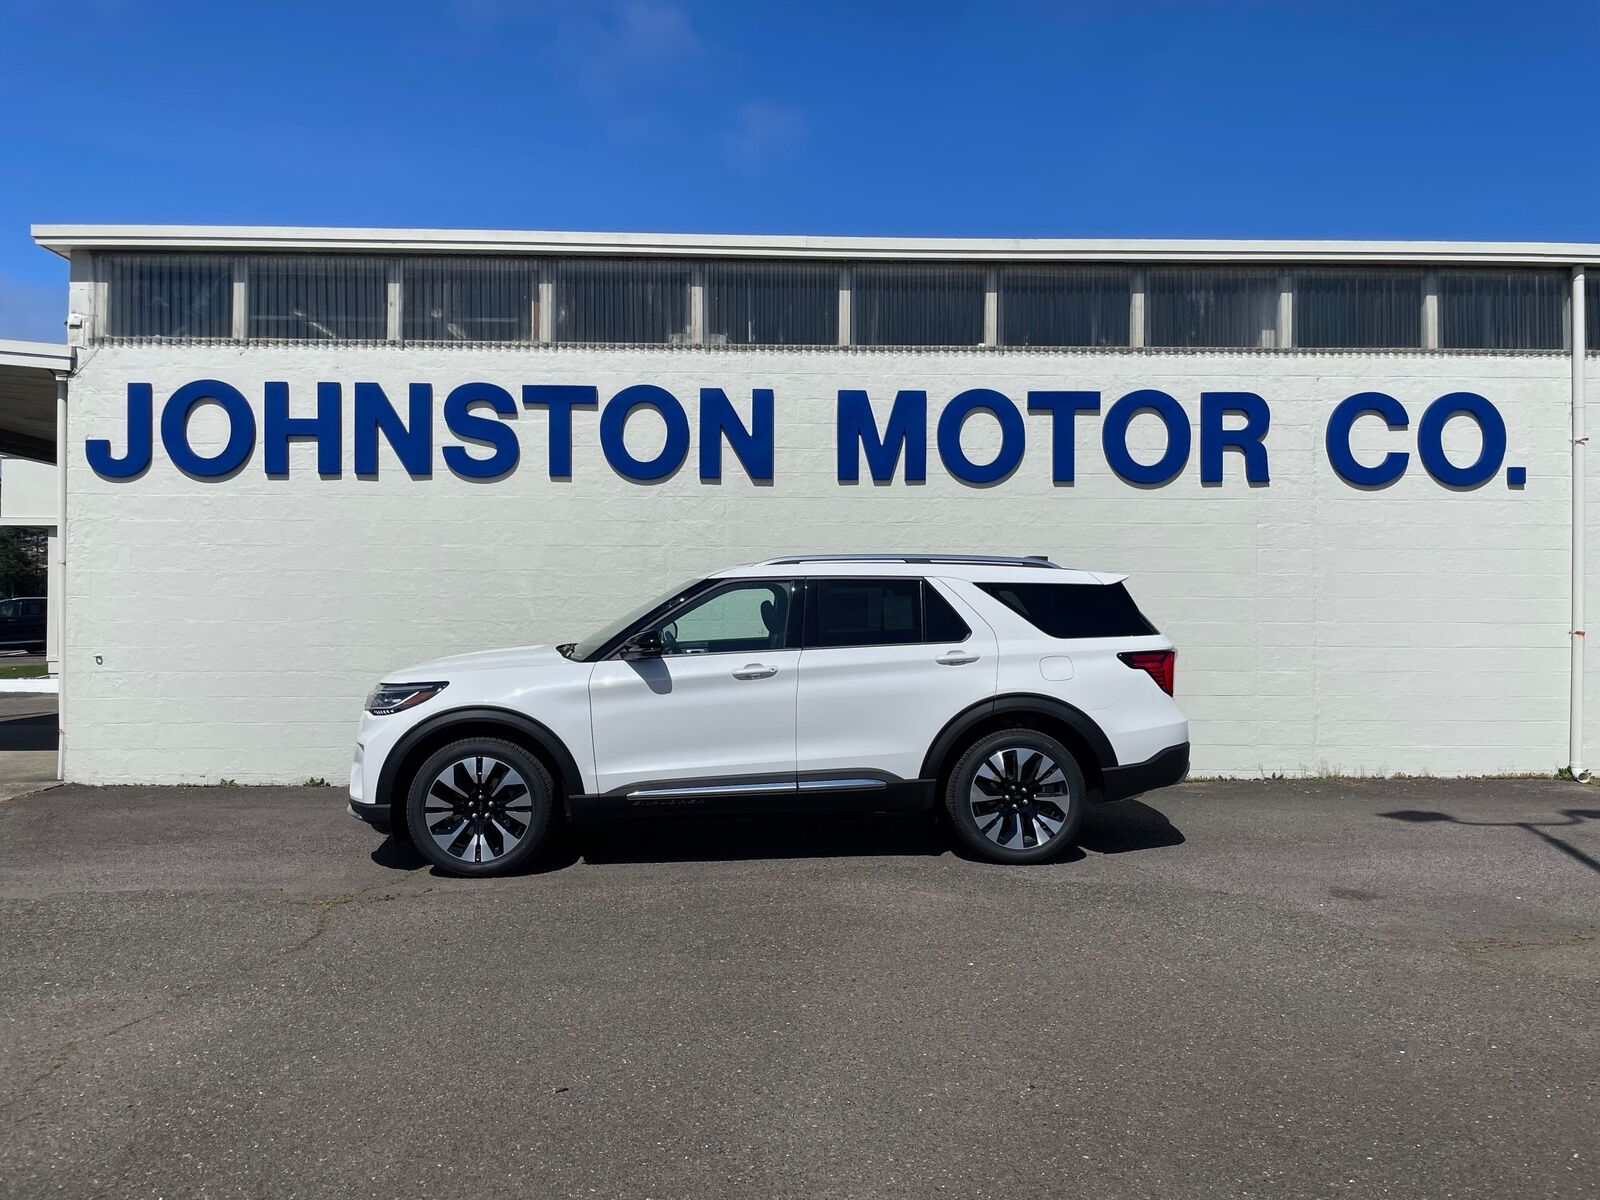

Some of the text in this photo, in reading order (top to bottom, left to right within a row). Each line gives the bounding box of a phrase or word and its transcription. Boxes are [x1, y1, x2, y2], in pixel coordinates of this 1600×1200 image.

[86, 379, 1526, 488] JOHNSTON MOTOR CO.
